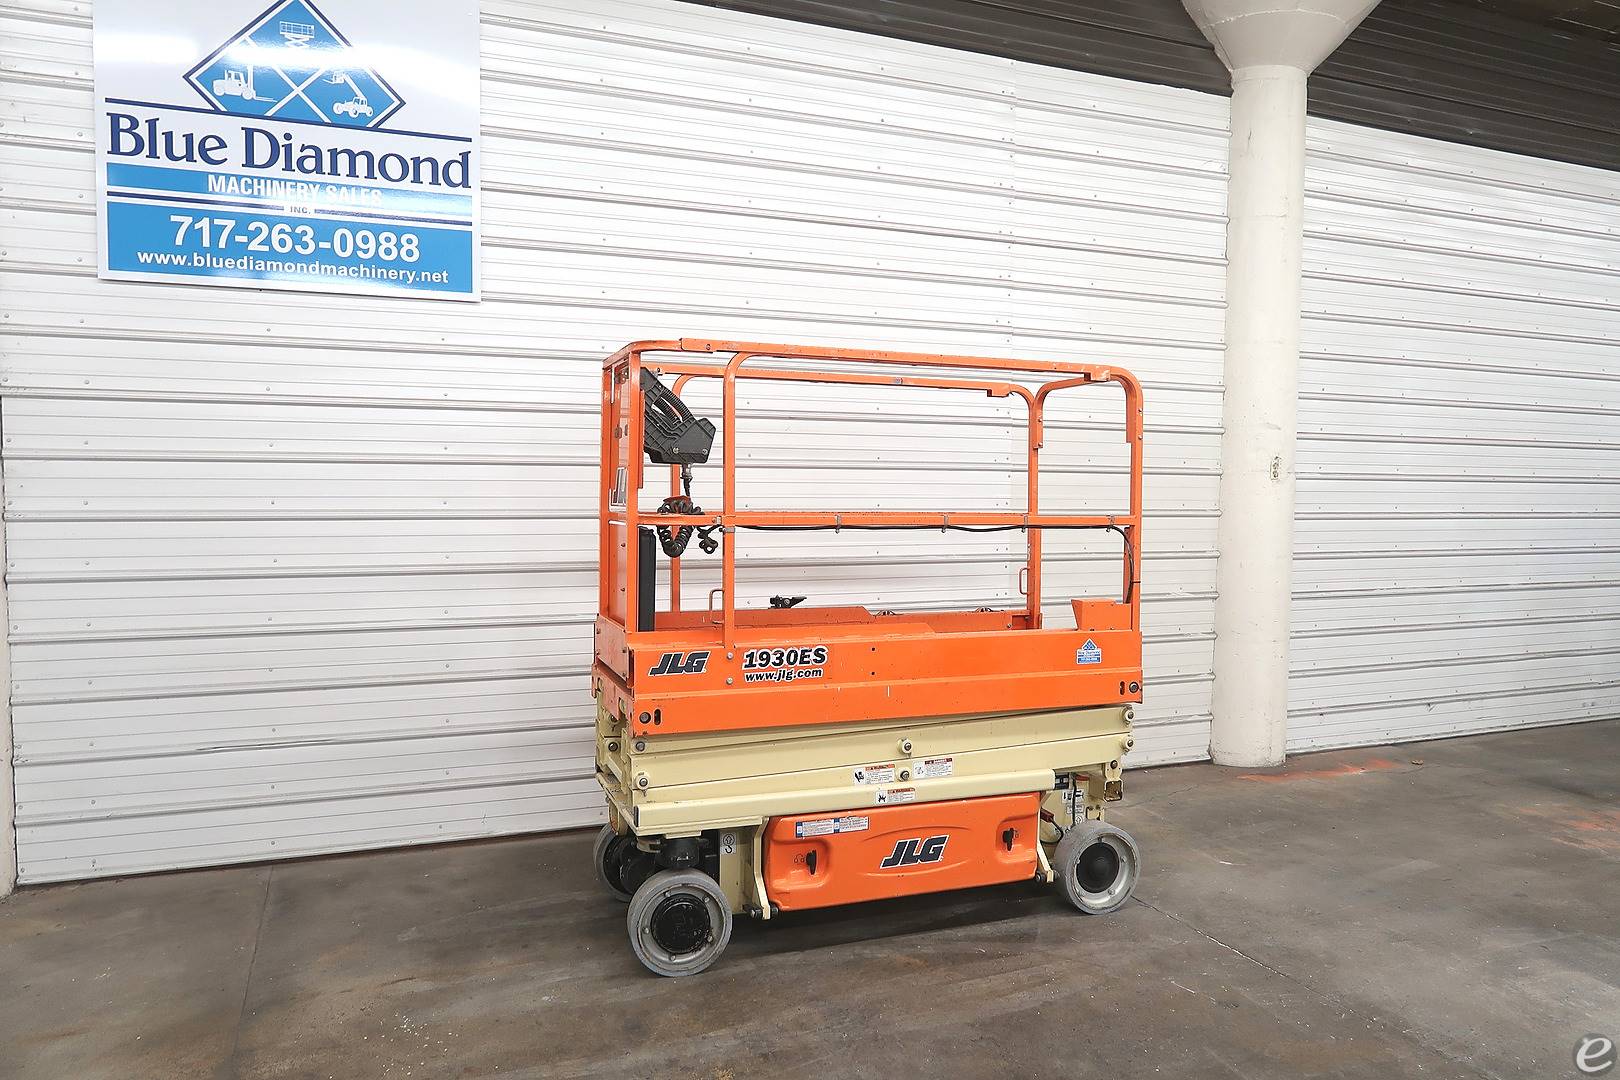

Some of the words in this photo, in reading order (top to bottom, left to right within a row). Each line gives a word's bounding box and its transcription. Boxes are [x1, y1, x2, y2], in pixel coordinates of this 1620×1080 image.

[106, 112, 228, 165] Blue
[240, 126, 472, 189] Diamond
[207, 174, 321, 200] MACHINERY
[325, 185, 383, 206] SALES
[289, 205, 312, 215] INC.
[170, 214, 421, 263] 717-263-0988
[137, 250, 449, 284] www.bluediamondmachinery.net
[649, 651, 710, 676] JLG
[742, 646, 828, 669] 1930ES
[744, 667, 823, 682] www.jlg.com
[881, 835, 949, 868] JLG
